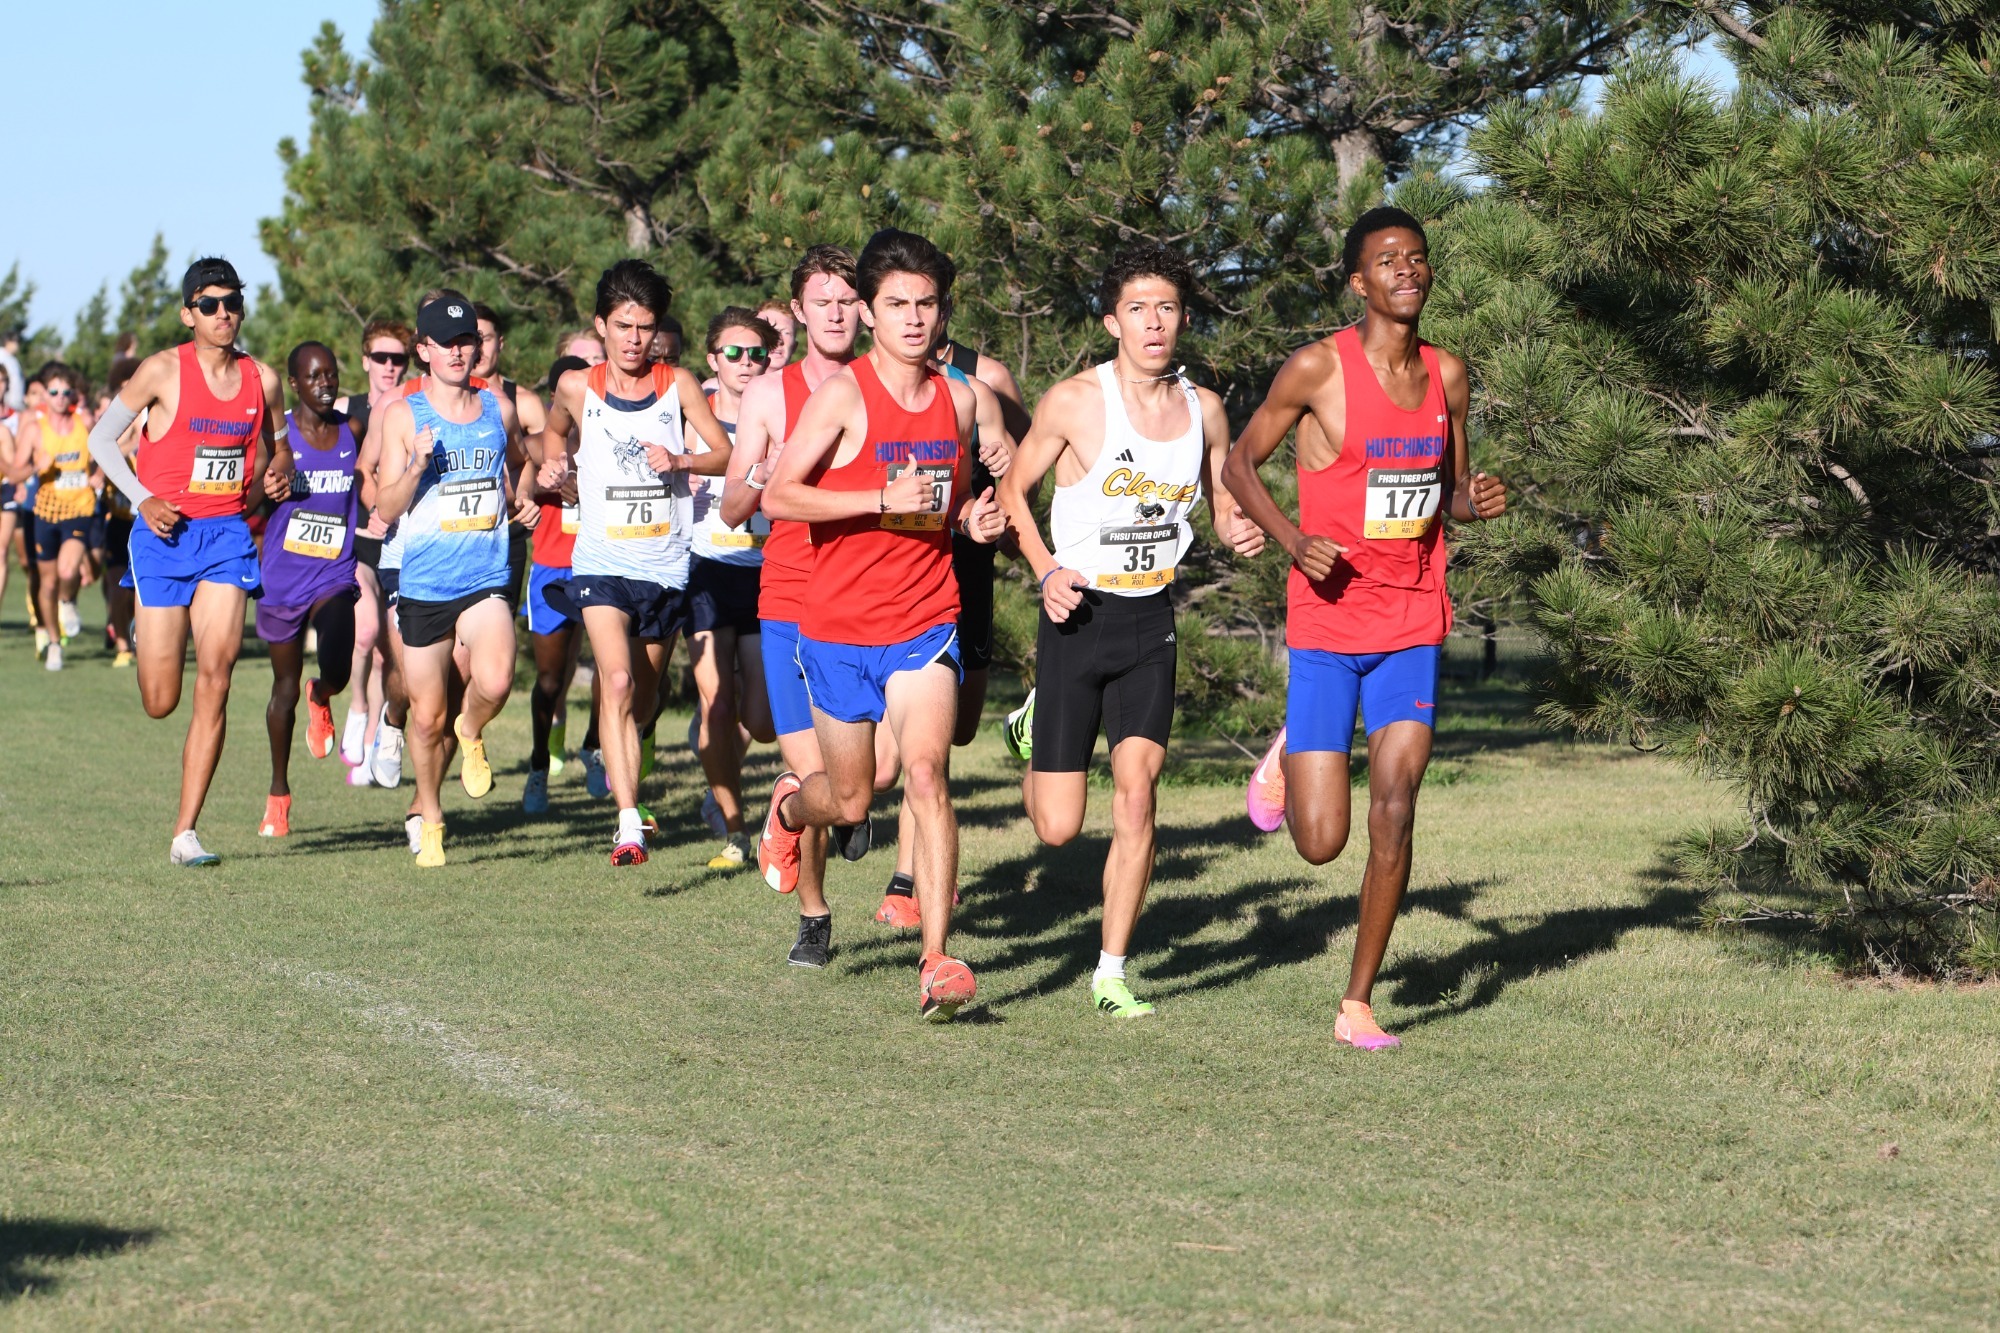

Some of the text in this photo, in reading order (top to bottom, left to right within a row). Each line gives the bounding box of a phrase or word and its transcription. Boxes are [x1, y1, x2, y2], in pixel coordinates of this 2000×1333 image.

[189, 417, 254, 436] HUTCHINSON
[875, 440, 959, 462] HUTCHINSON
[1365, 436, 1443, 458] HUTCHINSO
[205, 460, 237, 480] 178
[432, 448, 498, 475] COLBY
[936, 470, 950, 478] OPEN
[1378, 472, 1437, 483] FHSU TIGER OPEN
[630, 490, 648, 498] TIGER
[1385, 488, 1431, 518] 177
[458, 494, 482, 516] 47
[626, 502, 652, 524] 76
[298, 523, 335, 544] 205
[1110, 529, 1171, 541] FHSU TIGER OPEN
[1123, 545, 1156, 572] 35
